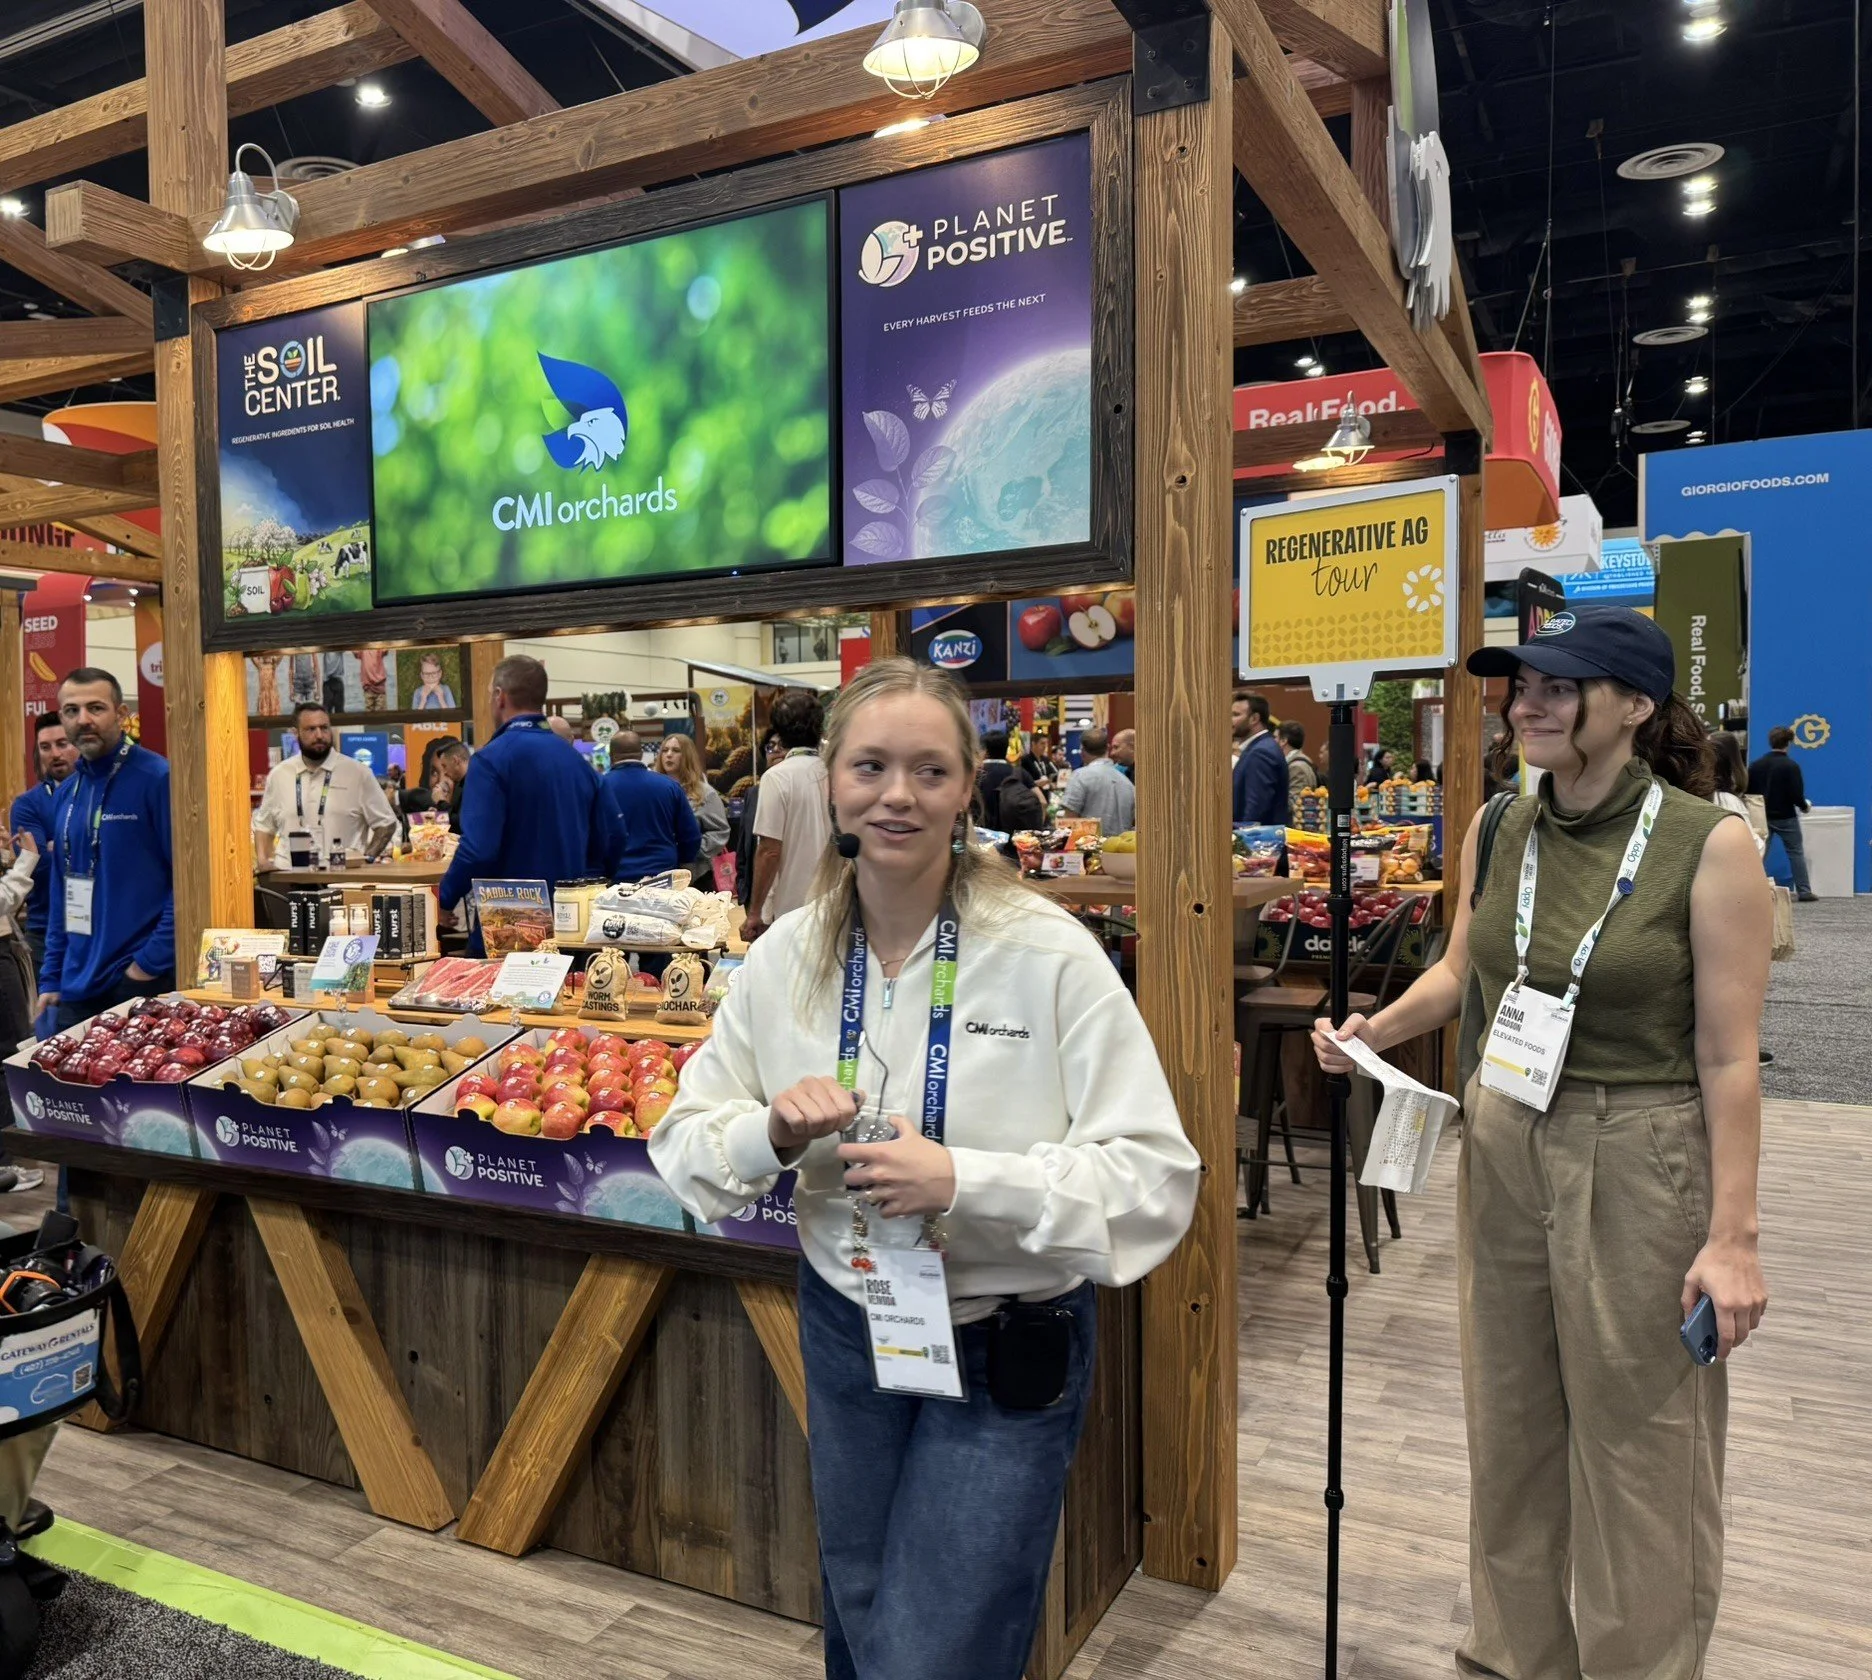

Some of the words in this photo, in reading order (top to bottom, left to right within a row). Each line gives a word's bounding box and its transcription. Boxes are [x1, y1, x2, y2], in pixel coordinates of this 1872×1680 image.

[934, 194, 1059, 240] PLANET
[927, 219, 1067, 271] POSITIVE
[883, 319, 914, 332] EVERY
[916, 310, 961, 325] HARVEST
[963, 304, 994, 317] FEEDS
[995, 299, 1016, 311] THE
[1018, 293, 1046, 307] NEXT
[244, 353, 256, 391] THE
[257, 335, 338, 385] SOIL
[1249, 401, 1312, 429] Real
[231, 432, 271, 444] REGENERATIVE
[271, 425, 307, 438] INGREDIENTS
[307, 423, 319, 432] FOR
[319, 421, 332, 430] SOIL
[332, 418, 355, 429] HEALTH
[1681, 472, 1830, 497] GIORGIOFOODS.COM
[492, 491, 553, 531] CMI
[557, 475, 679, 524] orchards
[1265, 521, 1396, 565] REGENERATIVE
[1401, 516, 1429, 547] AG
[1310, 556, 1378, 597] tour
[246, 585, 265, 597] SOIL
[24, 615, 58, 633] SEED
[1690, 615, 1707, 651] Real
[1687, 655, 1706, 701] Food,
[25, 701, 49, 717] FUL
[1627, 841, 1642, 863] Oppy
[478, 886, 514, 903] SADDLE
[516, 886, 544, 905] ROCK
[1521, 886, 1533, 909] Oppy
[389, 909, 398, 938] nurst
[939, 920, 957, 956] CMI
[848, 926, 865, 987] orchards
[1573, 943, 1589, 967] Oppy
[587, 990, 611, 1001] WORM
[932, 956, 952, 1019] orchards
[844, 988, 861, 1023] CMI
[1500, 1004, 1525, 1023] ANNA
[966, 1021, 988, 1035] CMI
[989, 1024, 1030, 1039] orchards
[1492, 1029, 1524, 1046] ELEVATED
[1523, 1039, 1546, 1056] FOODS
[928, 1043, 947, 1079] CMI
[45, 1097, 84, 1113] PLANET
[47, 1109, 93, 1126] POSITIVE
[241, 1122, 290, 1139] PLANET
[242, 1136, 298, 1153] POSITIVE
[478, 1153, 537, 1172] PLANET
[478, 1168, 545, 1188] POSITIVE
